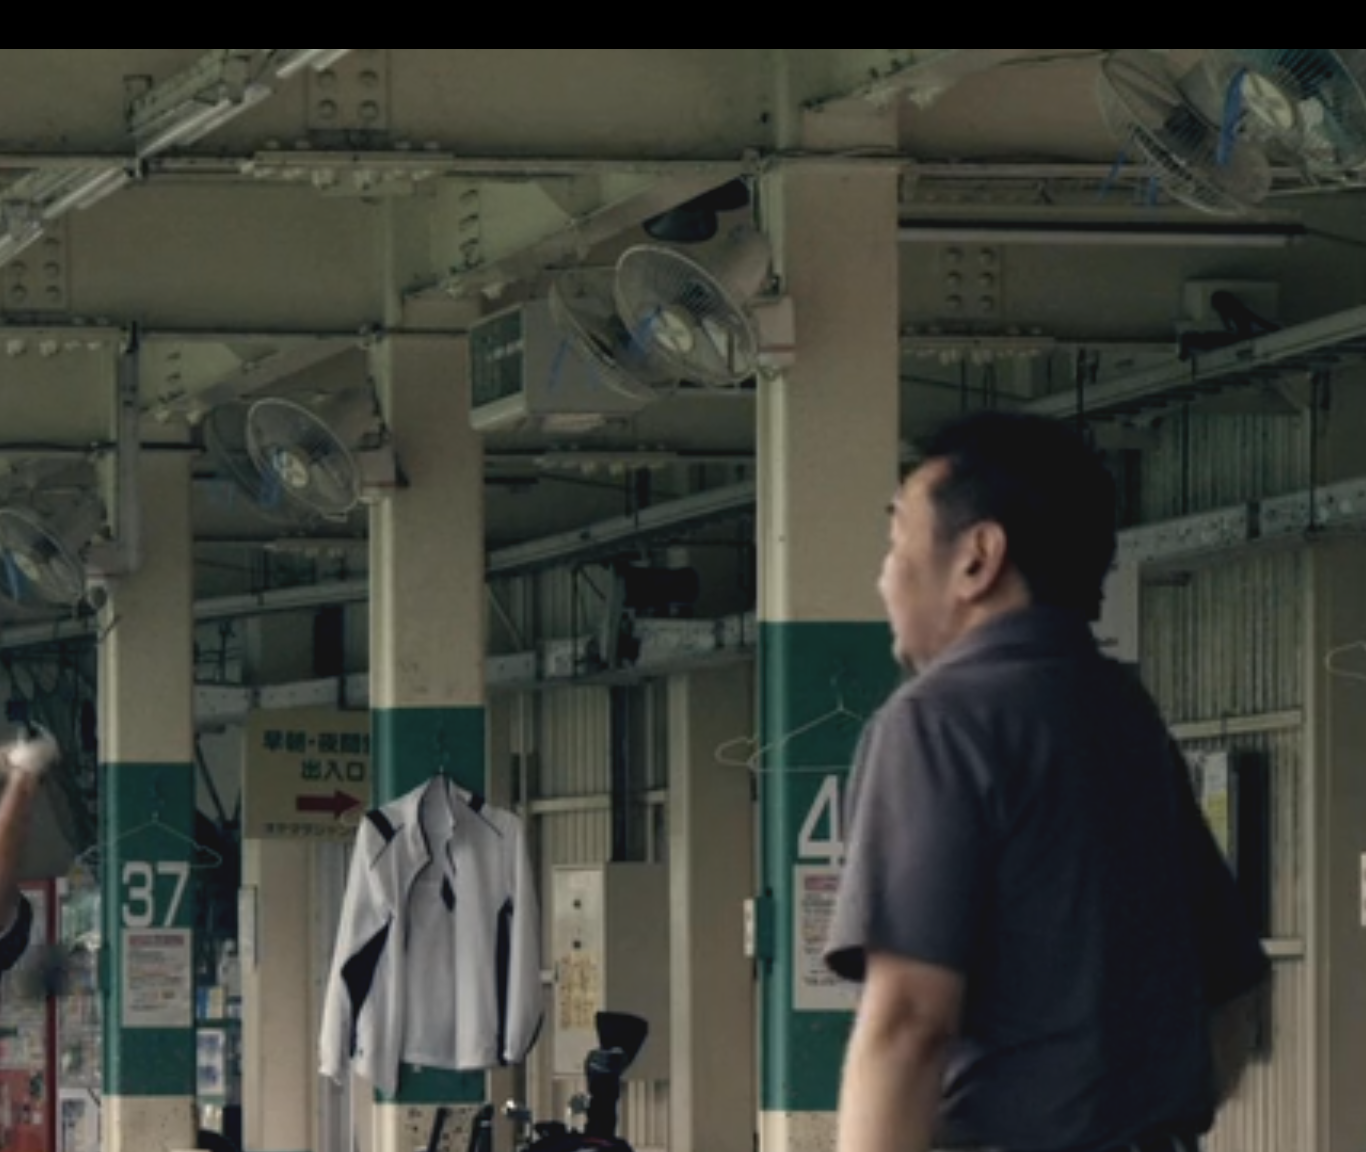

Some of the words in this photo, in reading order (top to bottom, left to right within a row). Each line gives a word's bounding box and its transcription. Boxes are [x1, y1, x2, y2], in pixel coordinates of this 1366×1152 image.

[301, 758, 365, 782] 出入口
[797, 775, 845, 865] 4
[121, 860, 190, 928] 37
